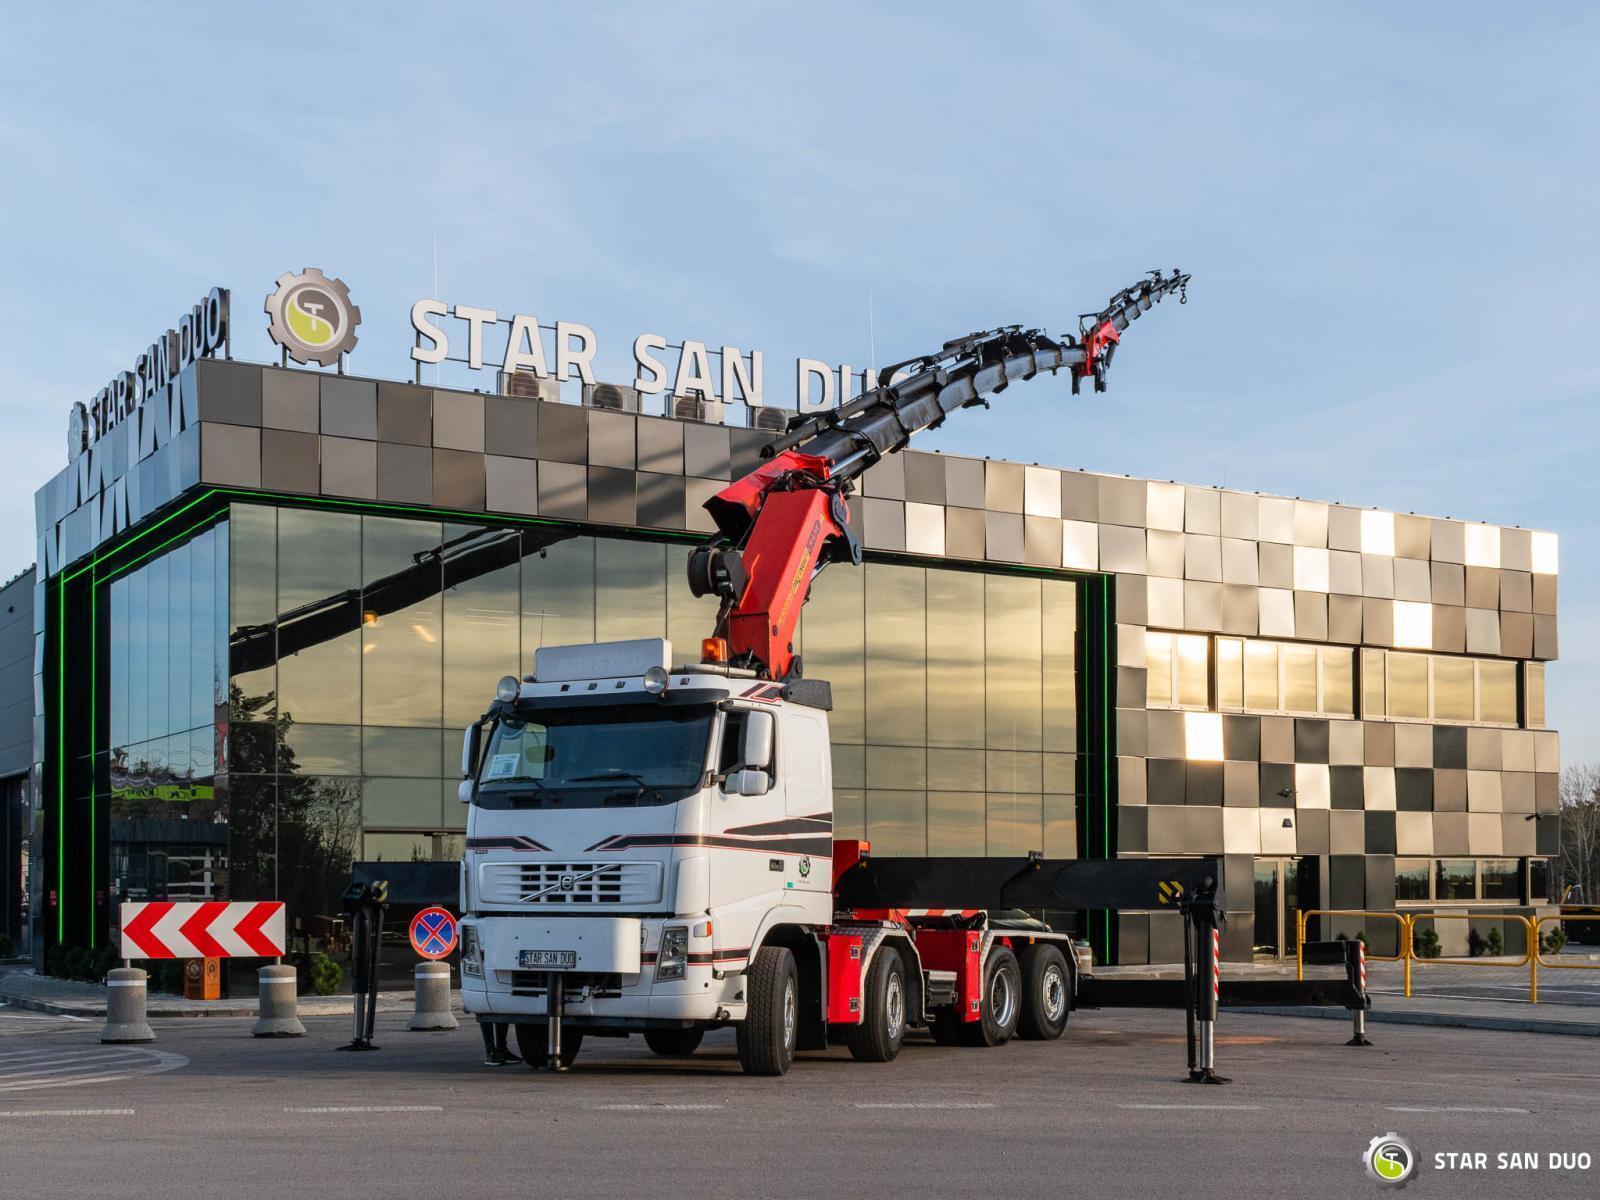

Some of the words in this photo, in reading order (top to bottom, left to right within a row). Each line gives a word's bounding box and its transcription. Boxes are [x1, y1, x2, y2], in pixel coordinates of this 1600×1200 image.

[88, 371, 133, 444] STAR
[135, 329, 176, 408] SAN
[179, 287, 224, 371] DUO
[411, 299, 597, 385] STAR
[633, 333, 763, 407] SAN
[525, 952, 542, 964] STAR
[545, 952, 558, 964] SAN
[561, 952, 574, 965] DUO
